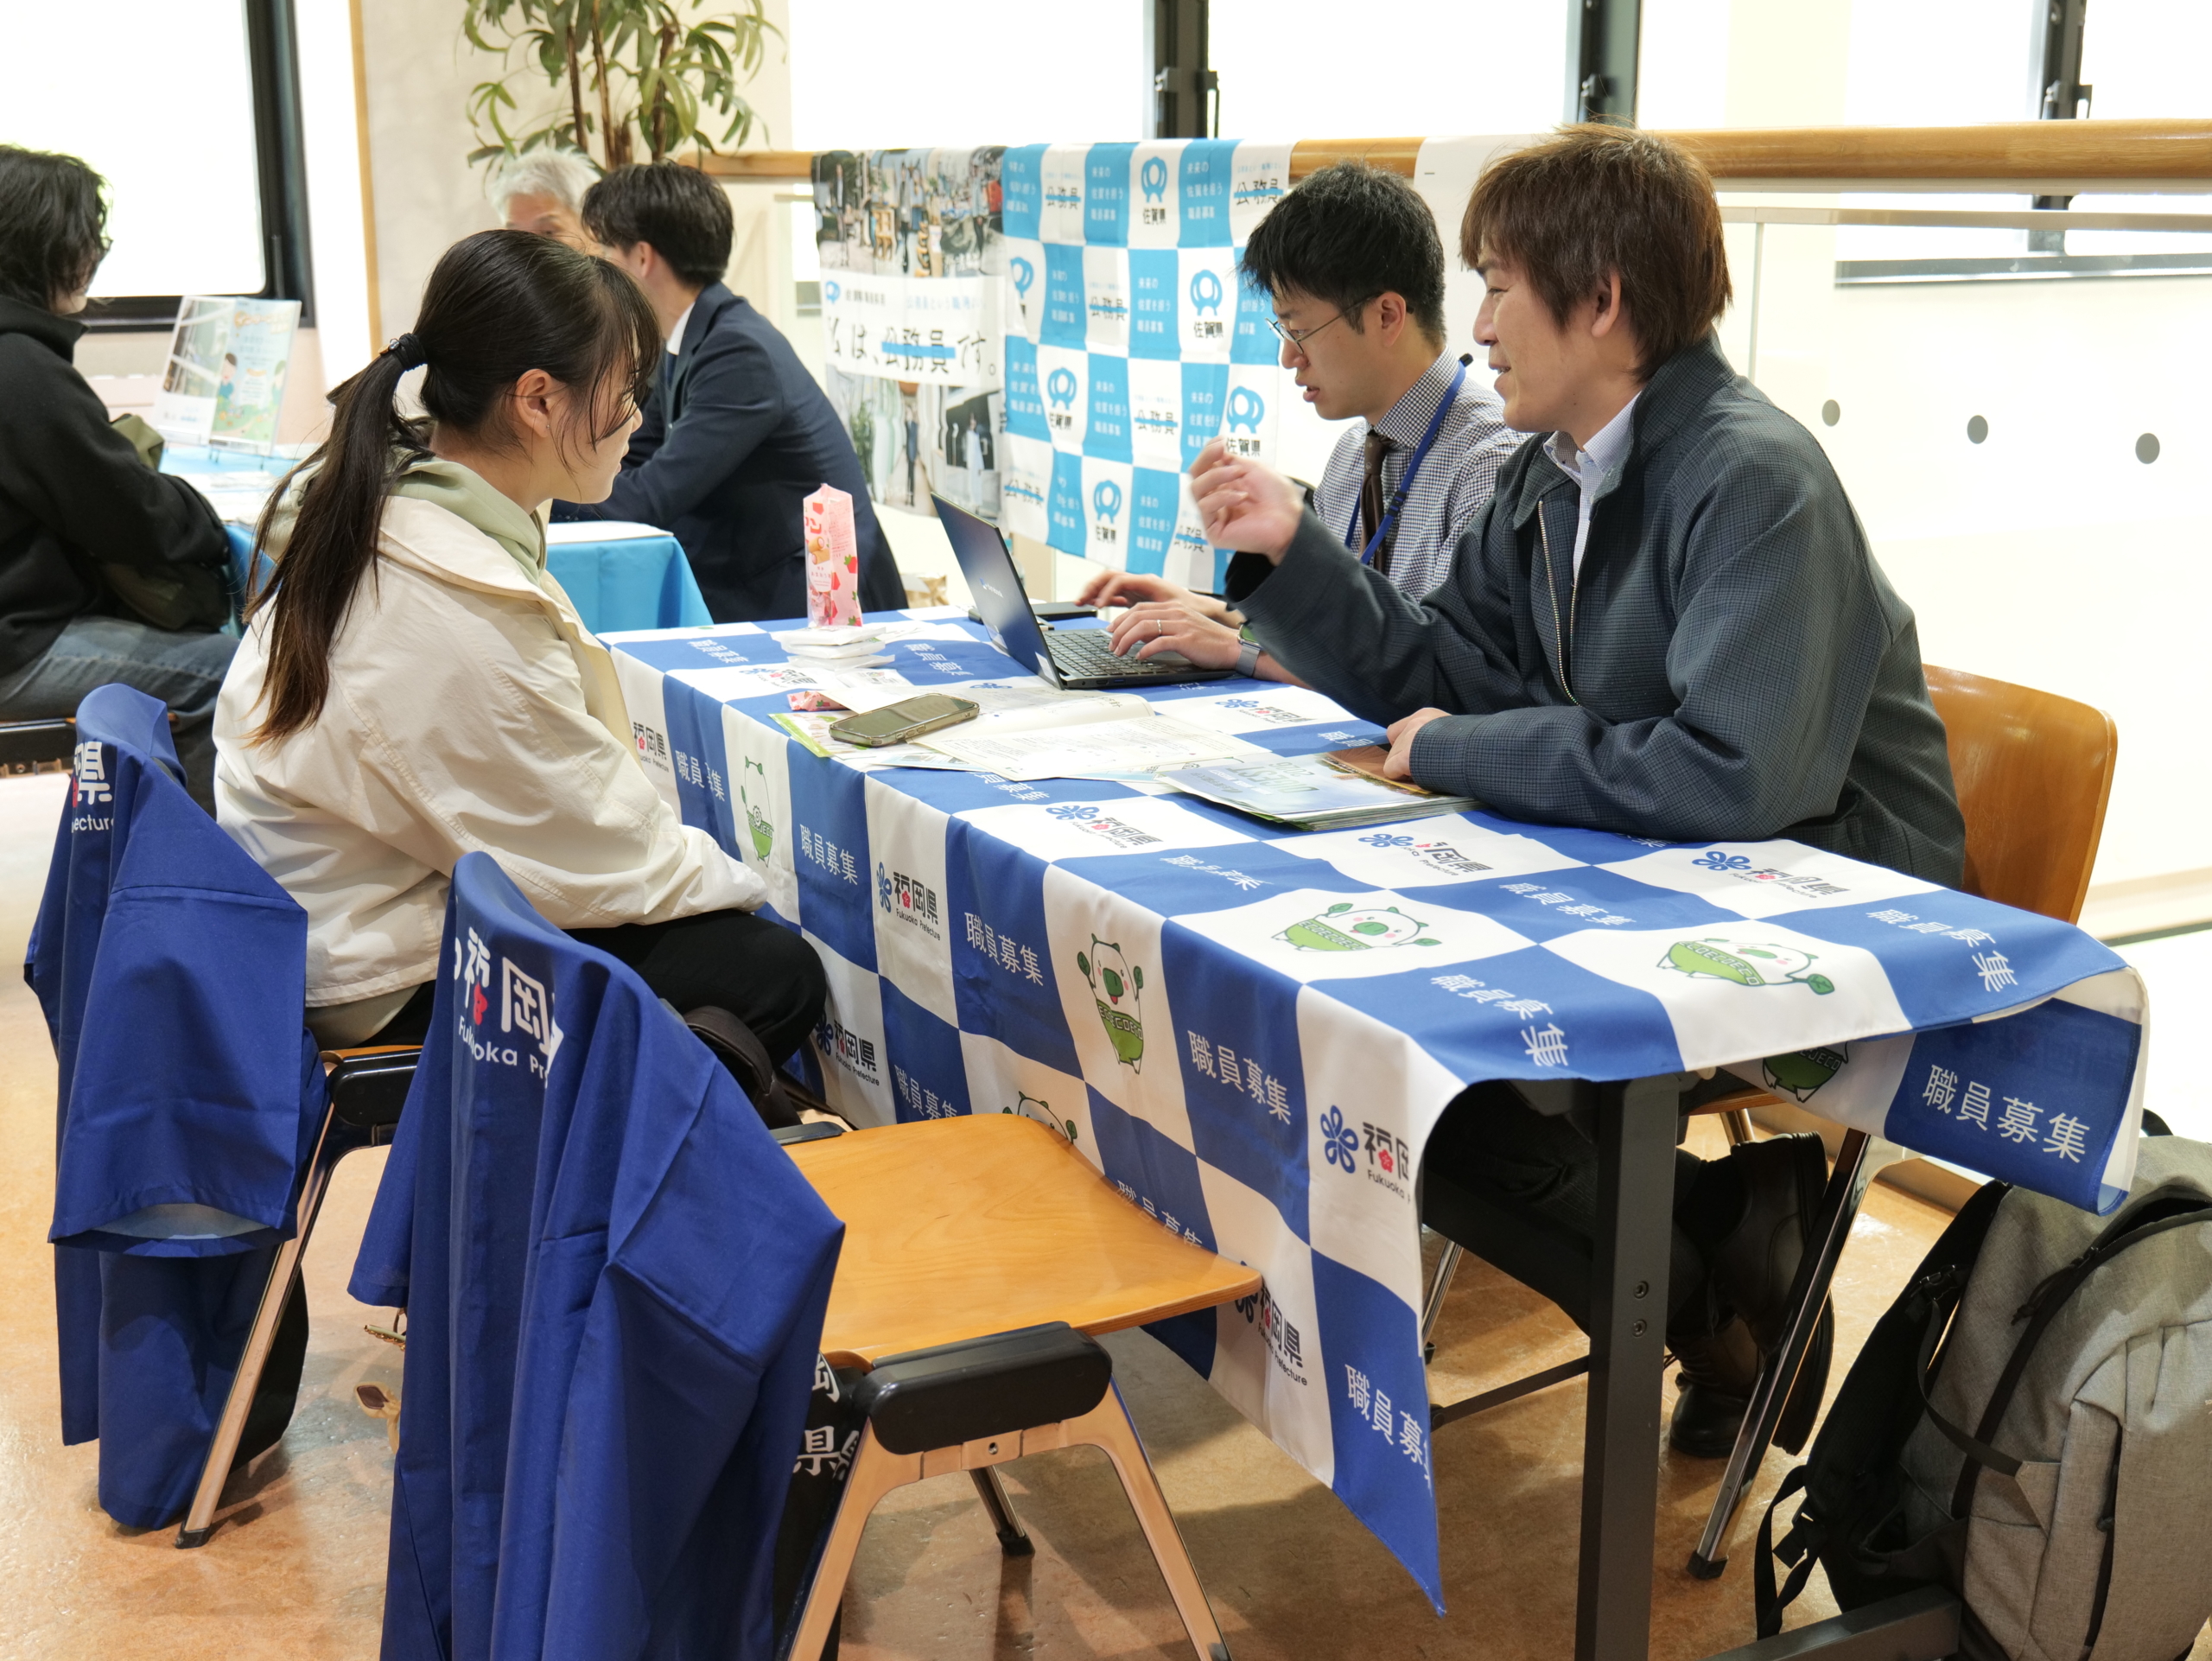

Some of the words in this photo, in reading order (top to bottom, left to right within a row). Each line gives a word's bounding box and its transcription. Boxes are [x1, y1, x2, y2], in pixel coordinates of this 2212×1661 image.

[1236, 178, 1280, 206] 公務員
[1142, 207, 1166, 225] 佐賀県
[1193, 321, 1224, 339] 佐賀県
[1136, 409, 1177, 436] 公務員
[1187, 435, 1211, 449] 職員
[1226, 437, 1262, 457] 佐賀県
[632, 721, 667, 760] 福岡県
[1318, 730, 1376, 748] 職員
[966, 772, 1051, 801] 員募集
[1084, 817, 1164, 846] 福岡県
[799, 824, 858, 886] 職員募集
[893, 871, 939, 926] 福岡県
[1744, 868, 1852, 895] 福岡県
[1498, 881, 1637, 926] 職員募集
[896, 907, 918, 926] Fukuoka
[919, 920, 941, 942] Prefecture
[963, 912, 1044, 987] 職員募集
[1866, 908, 2018, 993] 職員募集
[1430, 973, 1569, 1068] 職員募集
[833, 1019, 877, 1072] 福岡県
[852, 1064, 880, 1087] Prefecture
[1186, 1029, 1292, 1125] 職員募集
[1923, 1064, 2090, 1163] 職員募集
[1363, 1121, 1410, 1181] 福岡
[1367, 1168, 1405, 1200] Fukuoka
[1260, 1281, 1303, 1368] 福岡県
[1274, 1350, 1308, 1387] Prefecture
[1344, 1364, 1433, 1498] 職員募
